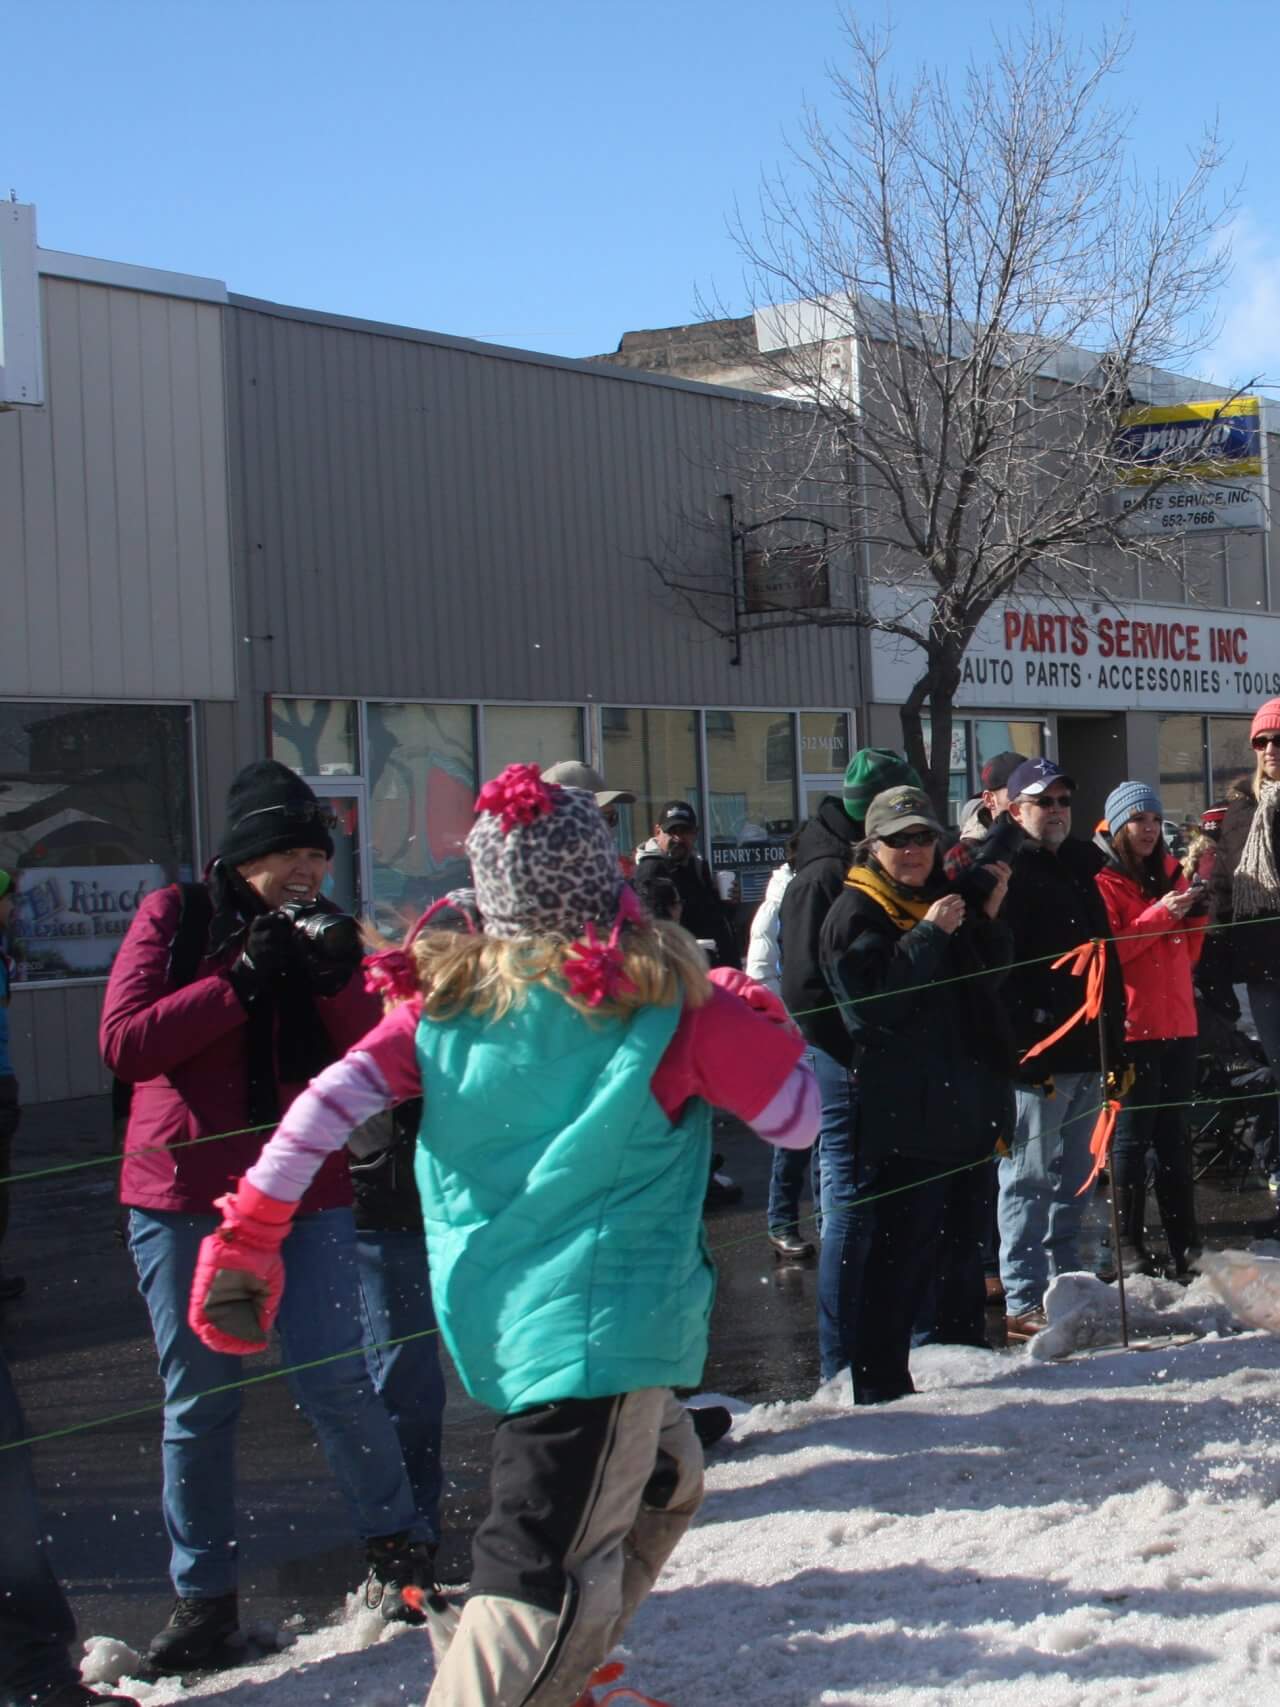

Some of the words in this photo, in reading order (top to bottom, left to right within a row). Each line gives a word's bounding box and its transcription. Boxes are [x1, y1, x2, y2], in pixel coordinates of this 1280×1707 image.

[1004, 611, 1088, 656] PARTS
[1098, 617, 1200, 661] SERVICE
[1209, 627, 1248, 664] INC
[962, 656, 1013, 685] AUTO
[1026, 661, 1081, 688] PARTS
[1098, 665, 1220, 693] ACCESSORIES
[1234, 671, 1280, 695] TOOLS
[713, 848, 761, 864] HENRY'S
